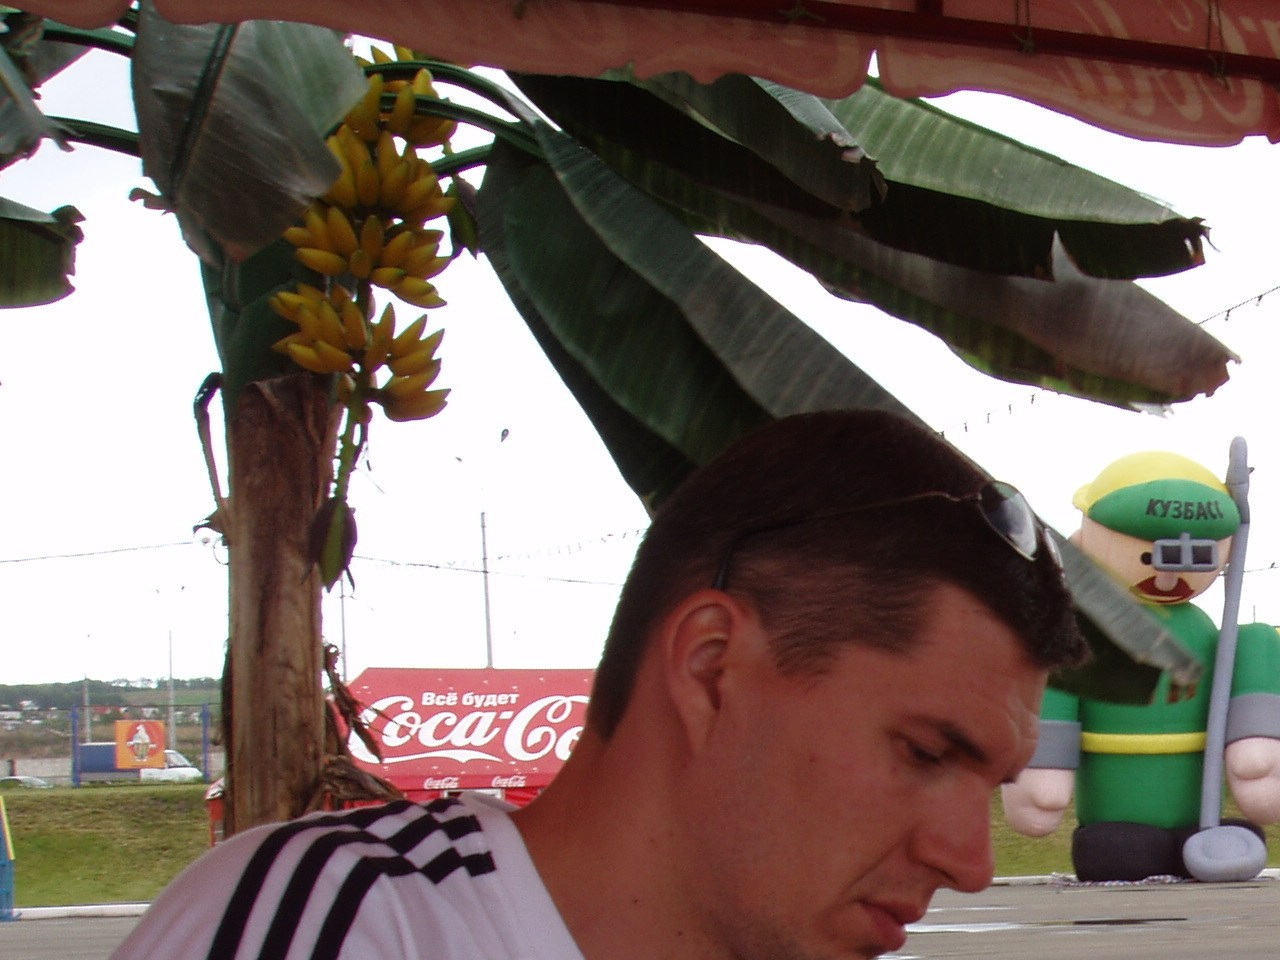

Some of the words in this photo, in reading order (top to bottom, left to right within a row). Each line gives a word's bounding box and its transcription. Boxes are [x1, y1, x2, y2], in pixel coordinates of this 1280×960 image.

[421, 691, 458, 706] Всё
[461, 692, 520, 708] будет
[348, 695, 589, 764] Coca-Co
